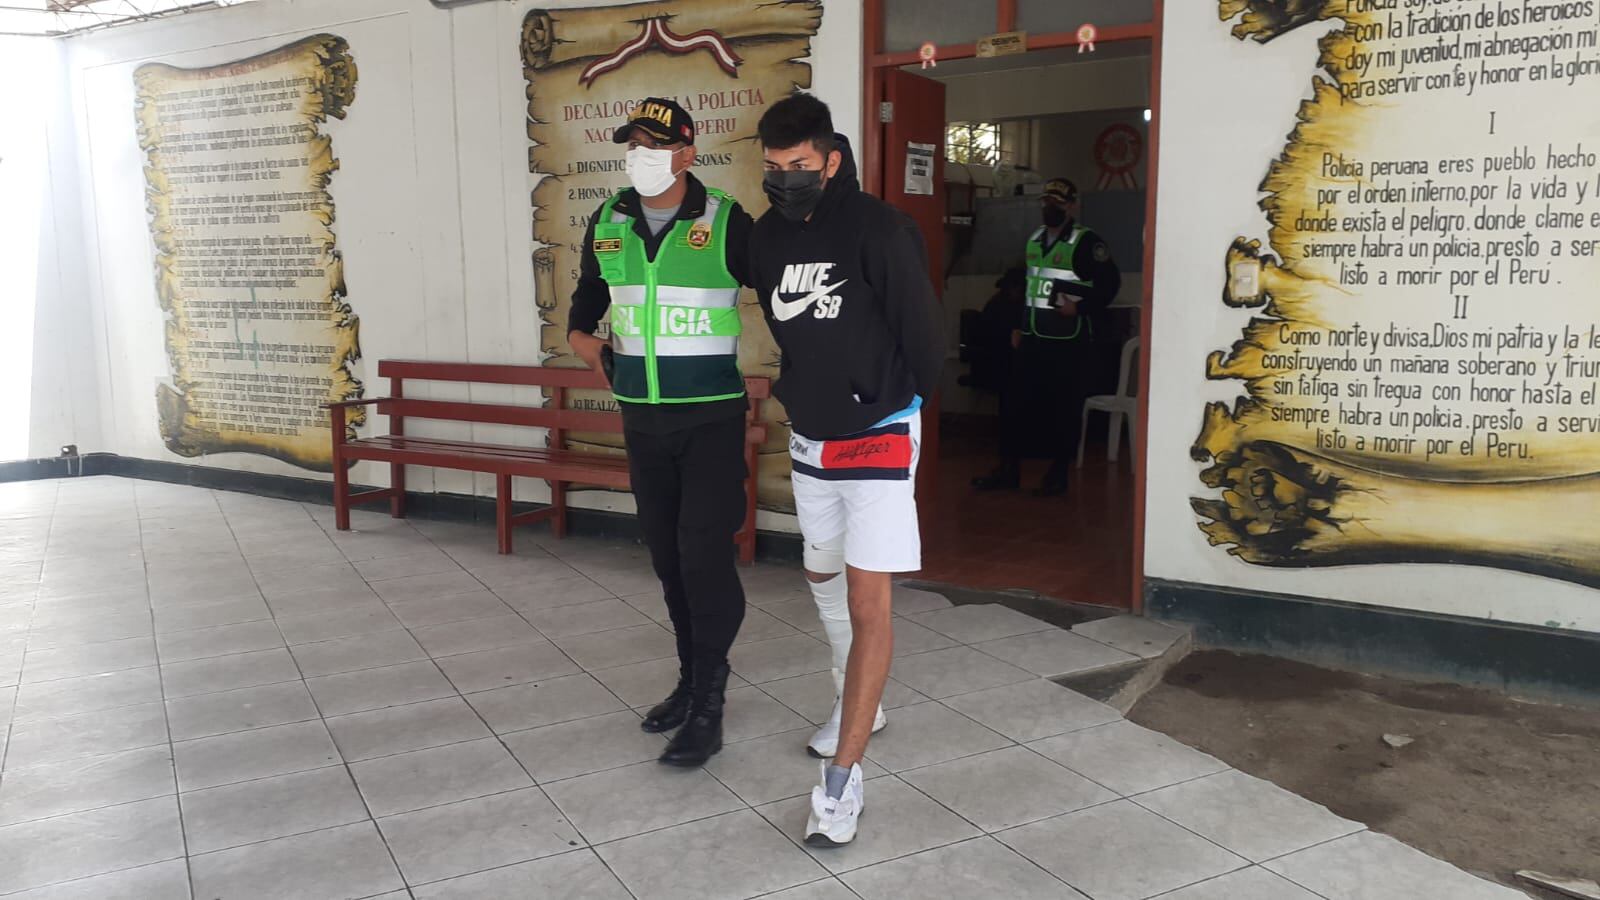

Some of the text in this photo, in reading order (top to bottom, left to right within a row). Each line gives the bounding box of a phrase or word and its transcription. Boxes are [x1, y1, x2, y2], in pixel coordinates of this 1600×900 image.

[1355, 0, 1593, 42] con la tradición de los heroicos
[1346, 46, 1373, 77] doy
[1377, 43, 1395, 67] mi
[1484, 25, 1572, 60] abnegación
[1577, 23, 1597, 48] mi
[1341, 80, 1375, 106] para
[1378, 72, 1423, 95] servir
[1426, 74, 1450, 89] con
[1453, 63, 1466, 87] fe
[1467, 71, 1477, 96] y
[1480, 60, 1525, 84] honor
[1529, 64, 1547, 80] en
[1551, 54, 1563, 79] la
[698, 88, 764, 111] POLICIA
[695, 118, 736, 136] PERU
[1488, 111, 1496, 135] I
[1370, 159, 1428, 182] peruana
[1438, 158, 1474, 173] eres
[1483, 145, 1536, 178] pueblo
[1547, 143, 1596, 169] hecho
[1317, 188, 1341, 211] por
[1348, 180, 1360, 203] el
[1364, 179, 1406, 203] orden
[1507, 175, 1521, 200] la
[1530, 175, 1566, 199] vida
[1575, 181, 1588, 205] y
[1295, 209, 1337, 231] donde
[1342, 208, 1386, 231] exista
[1392, 207, 1405, 230] el
[1474, 204, 1526, 230] donde
[1536, 203, 1584, 228] clame
[1303, 238, 1356, 264] siempre
[1409, 242, 1428, 257] un
[1551, 240, 1562, 256] a
[779, 263, 833, 293] NIKE
[1340, 261, 1368, 285] listo
[1378, 270, 1388, 285] a
[1397, 266, 1442, 285] morir
[1450, 269, 1480, 294] por
[1485, 259, 1500, 285] el
[814, 295, 843, 319] SB
[1453, 295, 1469, 319] II
[1279, 323, 1321, 345] Como
[1328, 322, 1368, 347] norte
[1371, 332, 1380, 355] y
[1473, 326, 1492, 348] mi
[1497, 323, 1543, 355] patria
[1545, 334, 1558, 356] y
[1564, 324, 1579, 349] la
[1261, 348, 1357, 377] construyendo
[1363, 358, 1382, 372] un
[1390, 354, 1450, 374] mañana
[1458, 351, 1537, 375] soberano
[1544, 361, 1557, 386] y
[1274, 374, 1596, 408] sin fatiga sin tregua con honor hasta el
[1271, 402, 1330, 429] siempre
[1339, 401, 1382, 425] habra
[1389, 410, 1408, 427] un
[1536, 416, 1547, 432] a
[1316, 427, 1346, 449] listo
[1355, 435, 1364, 450] a
[1373, 434, 1416, 453] morir
[1426, 438, 1453, 461] por
[1460, 434, 1475, 456] el
